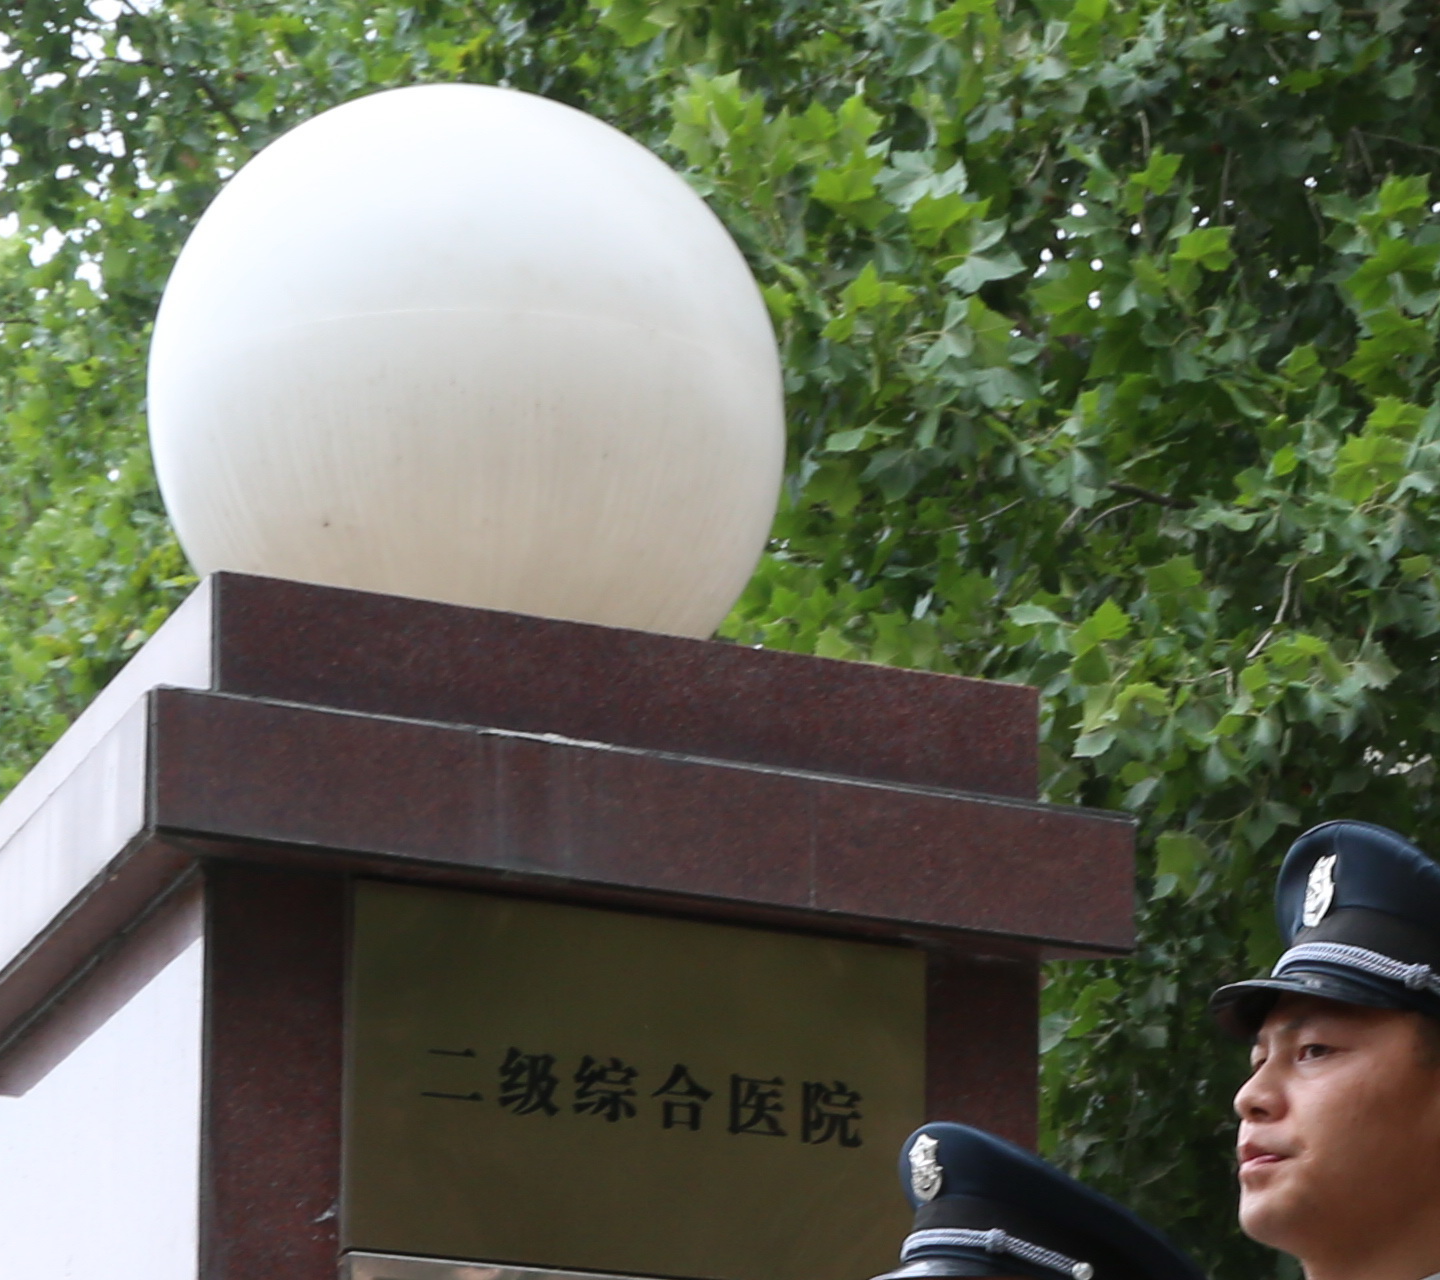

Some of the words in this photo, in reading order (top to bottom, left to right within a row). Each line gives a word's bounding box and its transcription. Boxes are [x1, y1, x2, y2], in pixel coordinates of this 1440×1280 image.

[419, 1047, 865, 1148] 二级综合医院
